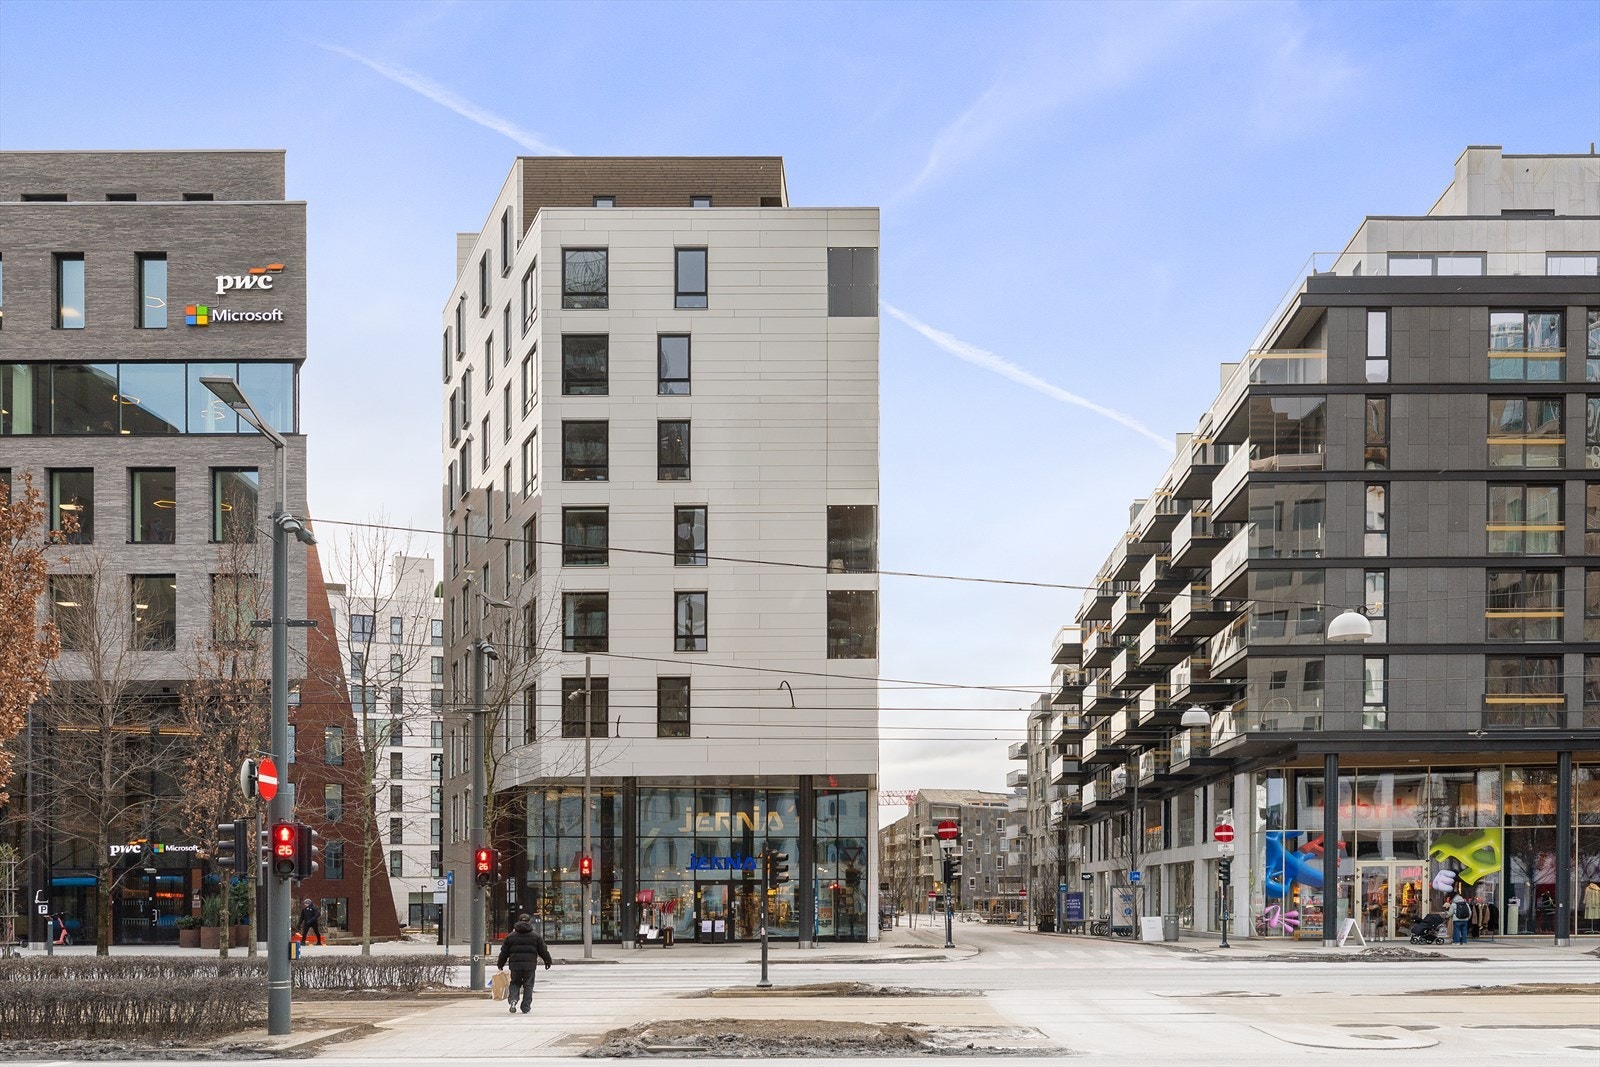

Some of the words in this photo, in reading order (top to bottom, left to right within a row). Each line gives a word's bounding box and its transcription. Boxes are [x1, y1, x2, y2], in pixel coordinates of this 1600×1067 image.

[215, 275, 273, 294] pwc
[212, 308, 283, 321] Microsoft
[109, 844, 141, 856] pwc
[165, 844, 199, 852] Microsoft
[278, 845, 293, 855] 26
[478, 862, 489, 871] 26
